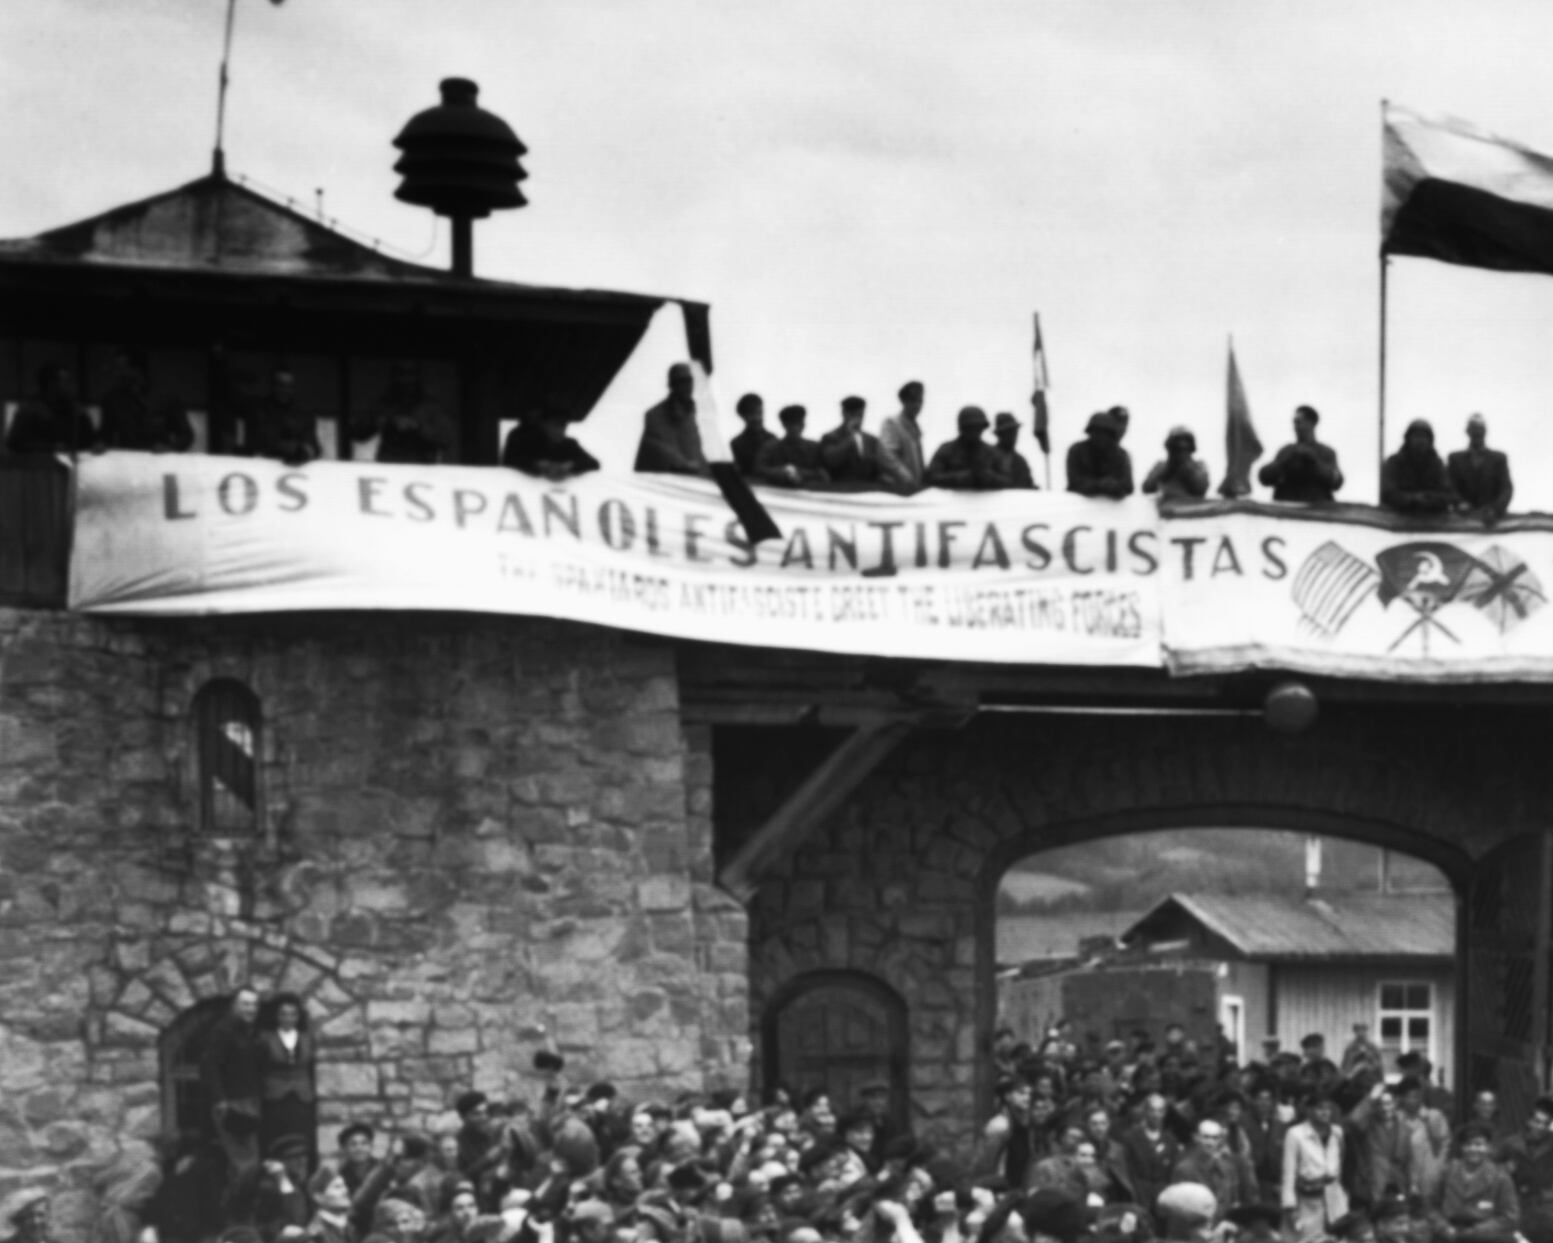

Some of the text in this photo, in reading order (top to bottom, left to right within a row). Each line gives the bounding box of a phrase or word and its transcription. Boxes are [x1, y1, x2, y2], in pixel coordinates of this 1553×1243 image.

[162, 473, 309, 521] LOS
[358, 475, 758, 568] ESPAÑOLES
[778, 520, 1287, 579] ANTIFASCISTAS
